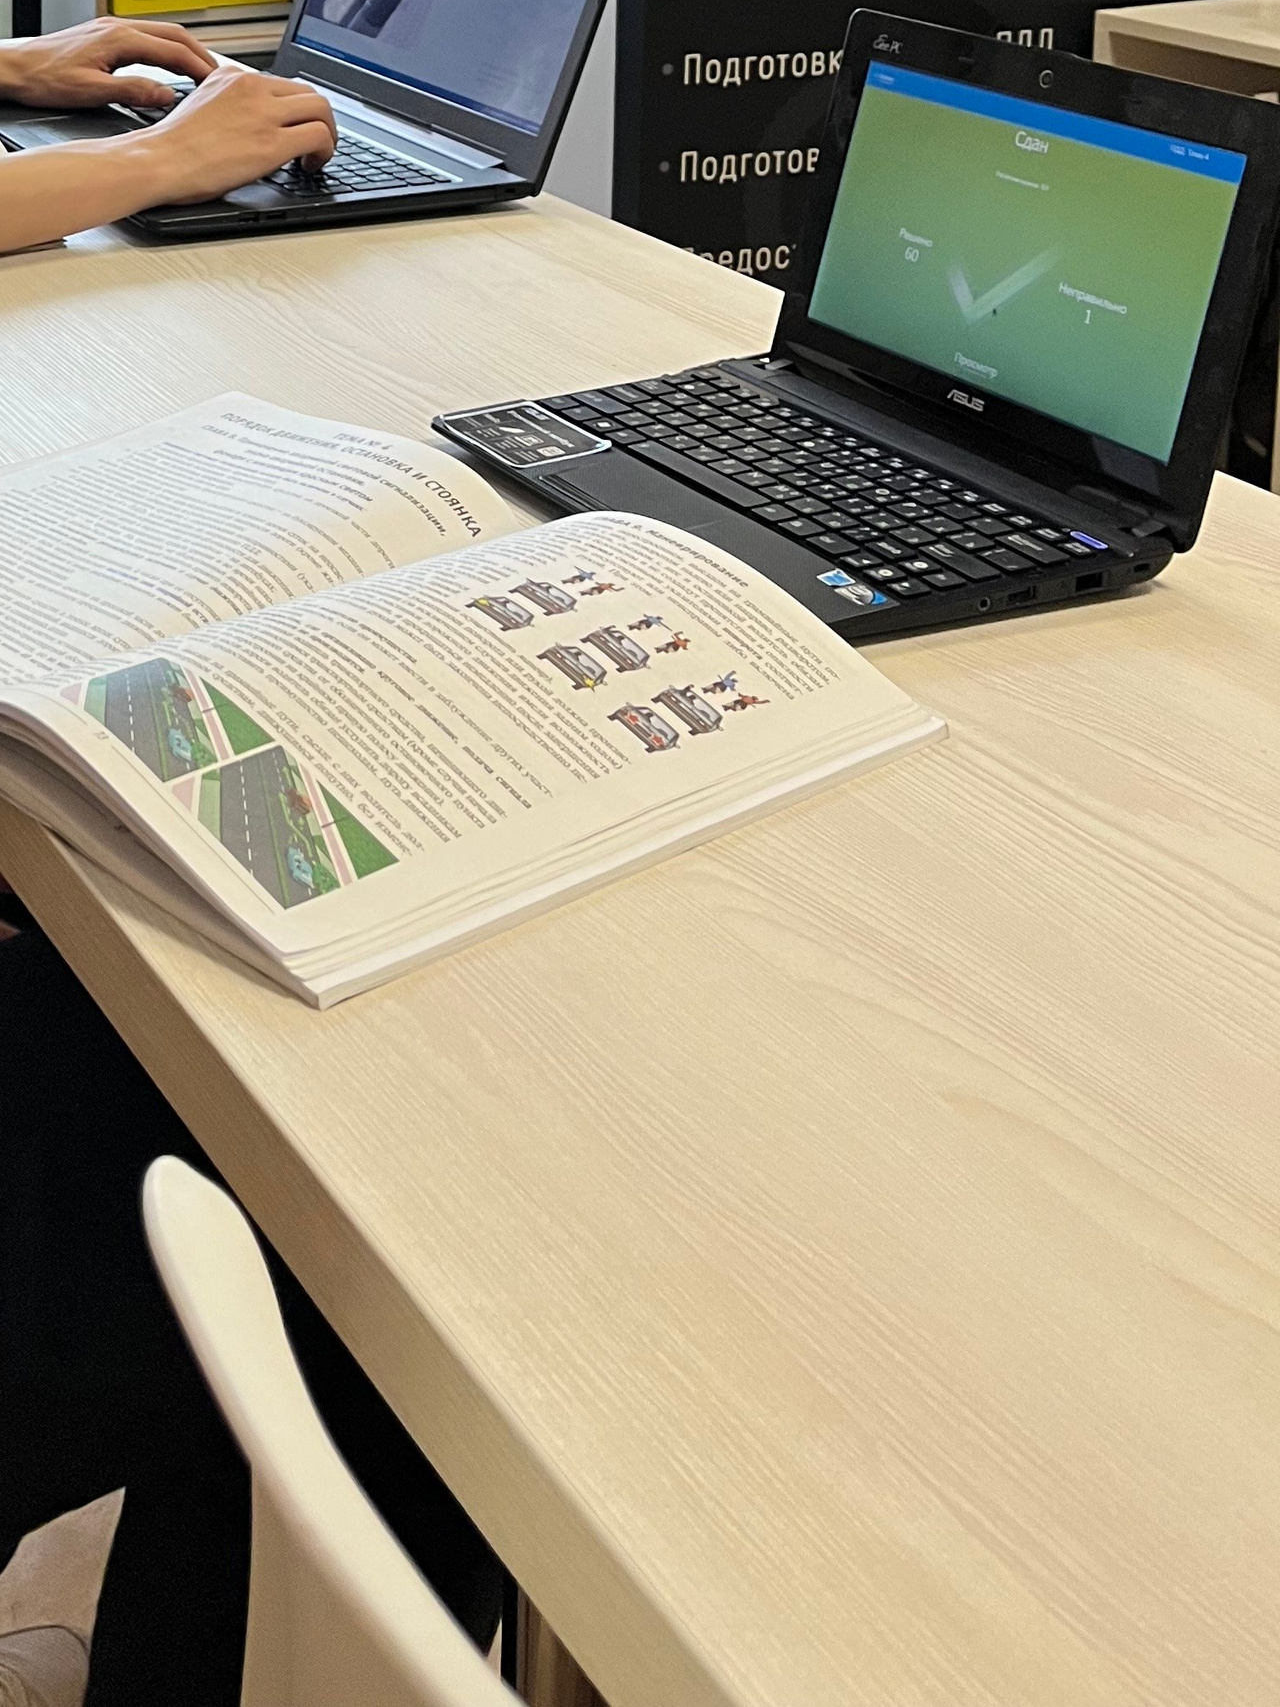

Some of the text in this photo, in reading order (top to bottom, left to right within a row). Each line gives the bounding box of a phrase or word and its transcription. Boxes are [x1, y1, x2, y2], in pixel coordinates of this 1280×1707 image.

[1014, 130, 1050, 155] Сдан
[904, 246, 920, 263] 60
[1083, 310, 1092, 325] 1
[946, 389, 985, 412] ASUS
[340, 444, 415, 475] ОСТАНОВКА
[411, 471, 429, 482] И
[424, 480, 483, 538] СТОЯНКА
[523, 672, 554, 696] рукой
[552, 695, 591, 727] должна
[434, 691, 494, 742] заблуждение
[490, 742, 525, 770] других
[521, 770, 555, 798] участ-
[491, 699, 573, 768] непосредственно
[515, 705, 546, 729] после
[542, 729, 601, 779] завершения
[549, 720, 613, 775] возможность
[405, 739, 439, 768] (кроме
[378, 760, 412, 790] дорогу
[355, 802, 375, 819] без
[359, 789, 404, 830] водитель
[378, 776, 403, 797] путь
[400, 797, 451, 843] движения
[451, 798, 487, 828] пункта
